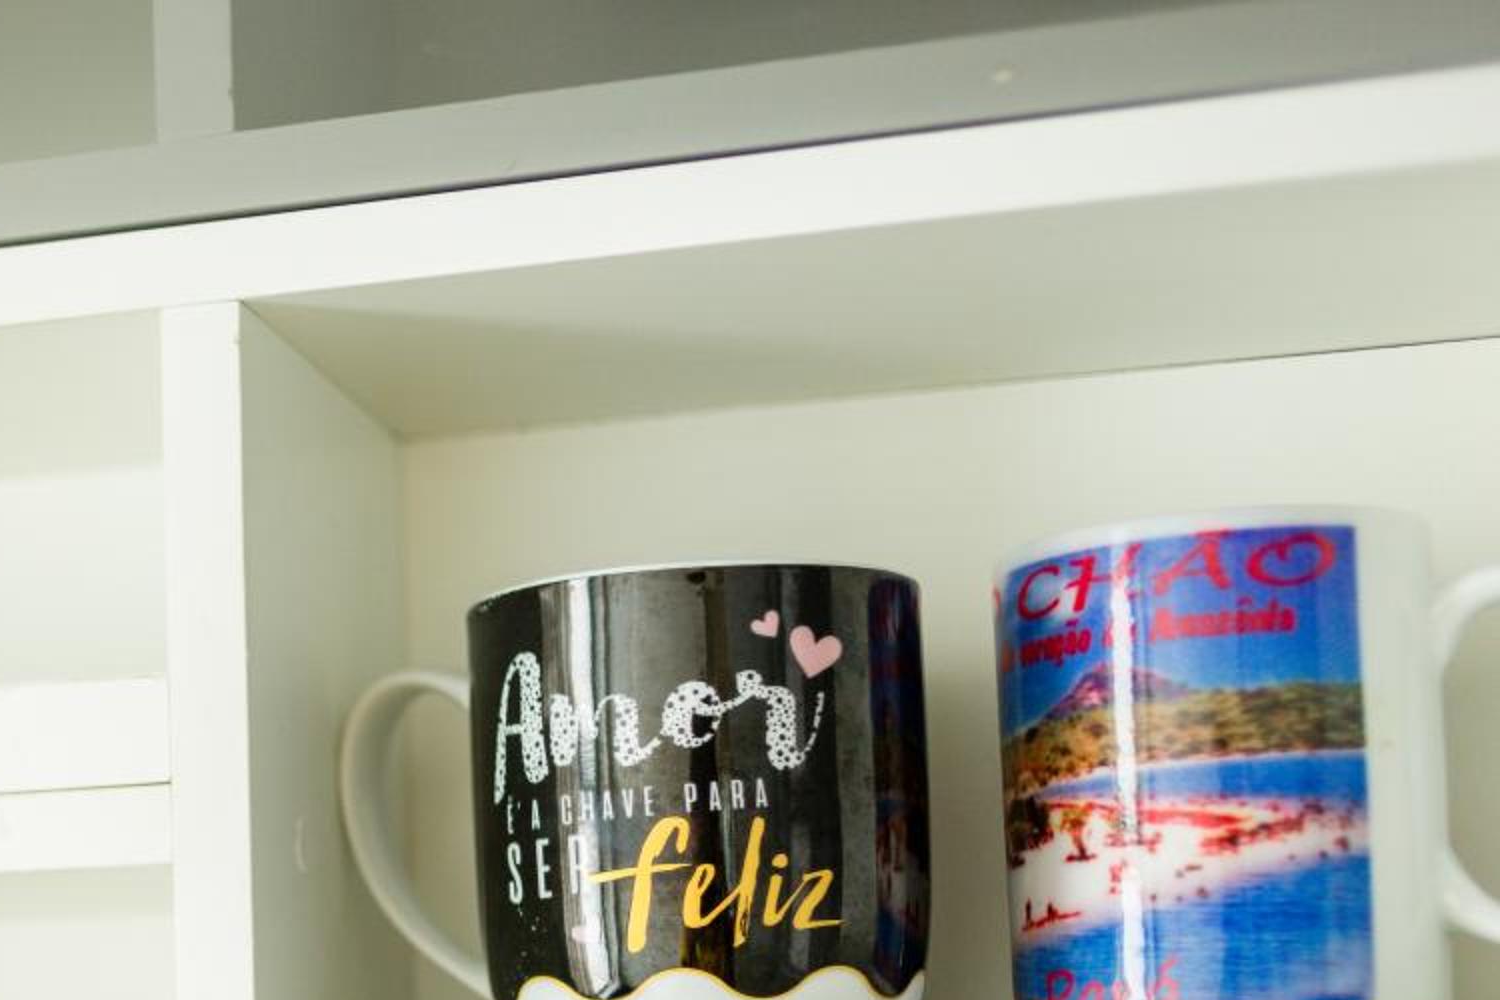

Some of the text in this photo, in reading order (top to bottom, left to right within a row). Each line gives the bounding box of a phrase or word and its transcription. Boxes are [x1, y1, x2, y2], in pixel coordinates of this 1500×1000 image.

[561, 784, 656, 825] CHAVE
[683, 777, 769, 813] PARA
[507, 816, 844, 953] SER feliz
